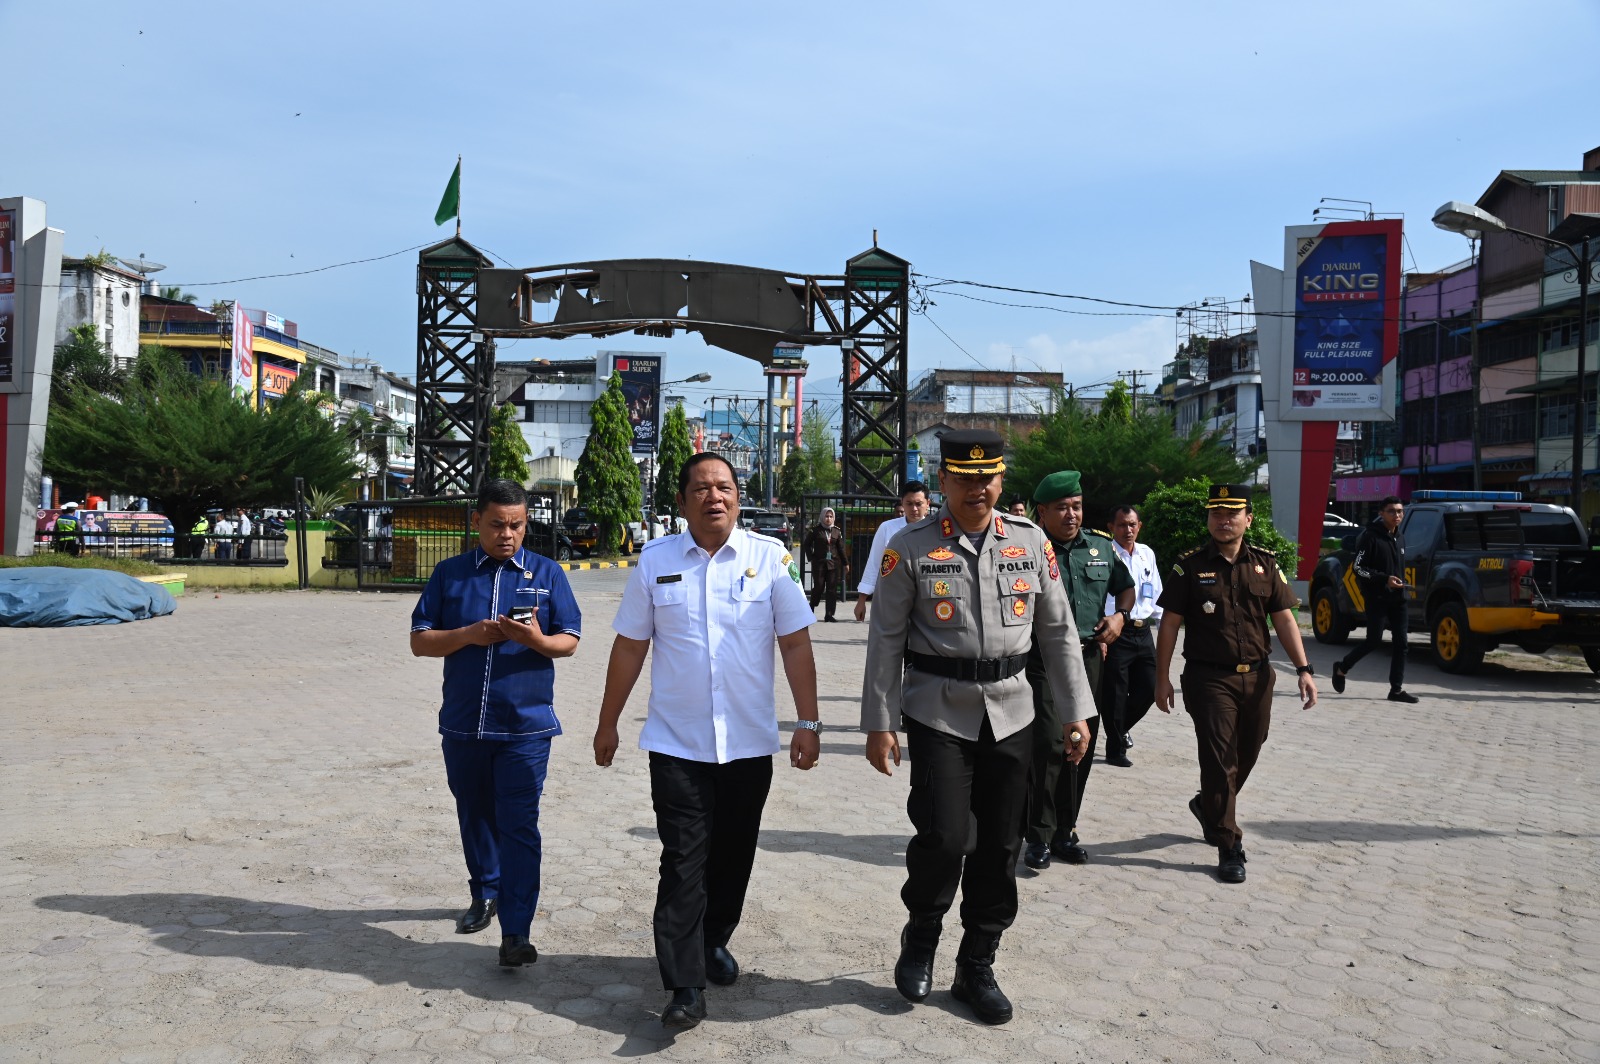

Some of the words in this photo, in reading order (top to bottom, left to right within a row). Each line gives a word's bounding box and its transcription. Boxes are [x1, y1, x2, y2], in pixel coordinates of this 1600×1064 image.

[1297, 238, 1315, 257] NEW
[1322, 262, 1361, 272] DJARUM
[1303, 273, 1379, 291] KING
[1316, 292, 1365, 300] FILTER
[1341, 341, 1361, 349] SIZE
[1327, 350, 1373, 358] PLEASURE
[632, 360, 658, 368] DJARUM
[1295, 372, 1306, 381] 12
[998, 560, 1035, 573] POLRI
[1478, 558, 1505, 569] PATROLI
[921, 564, 962, 574] PRASETYO
